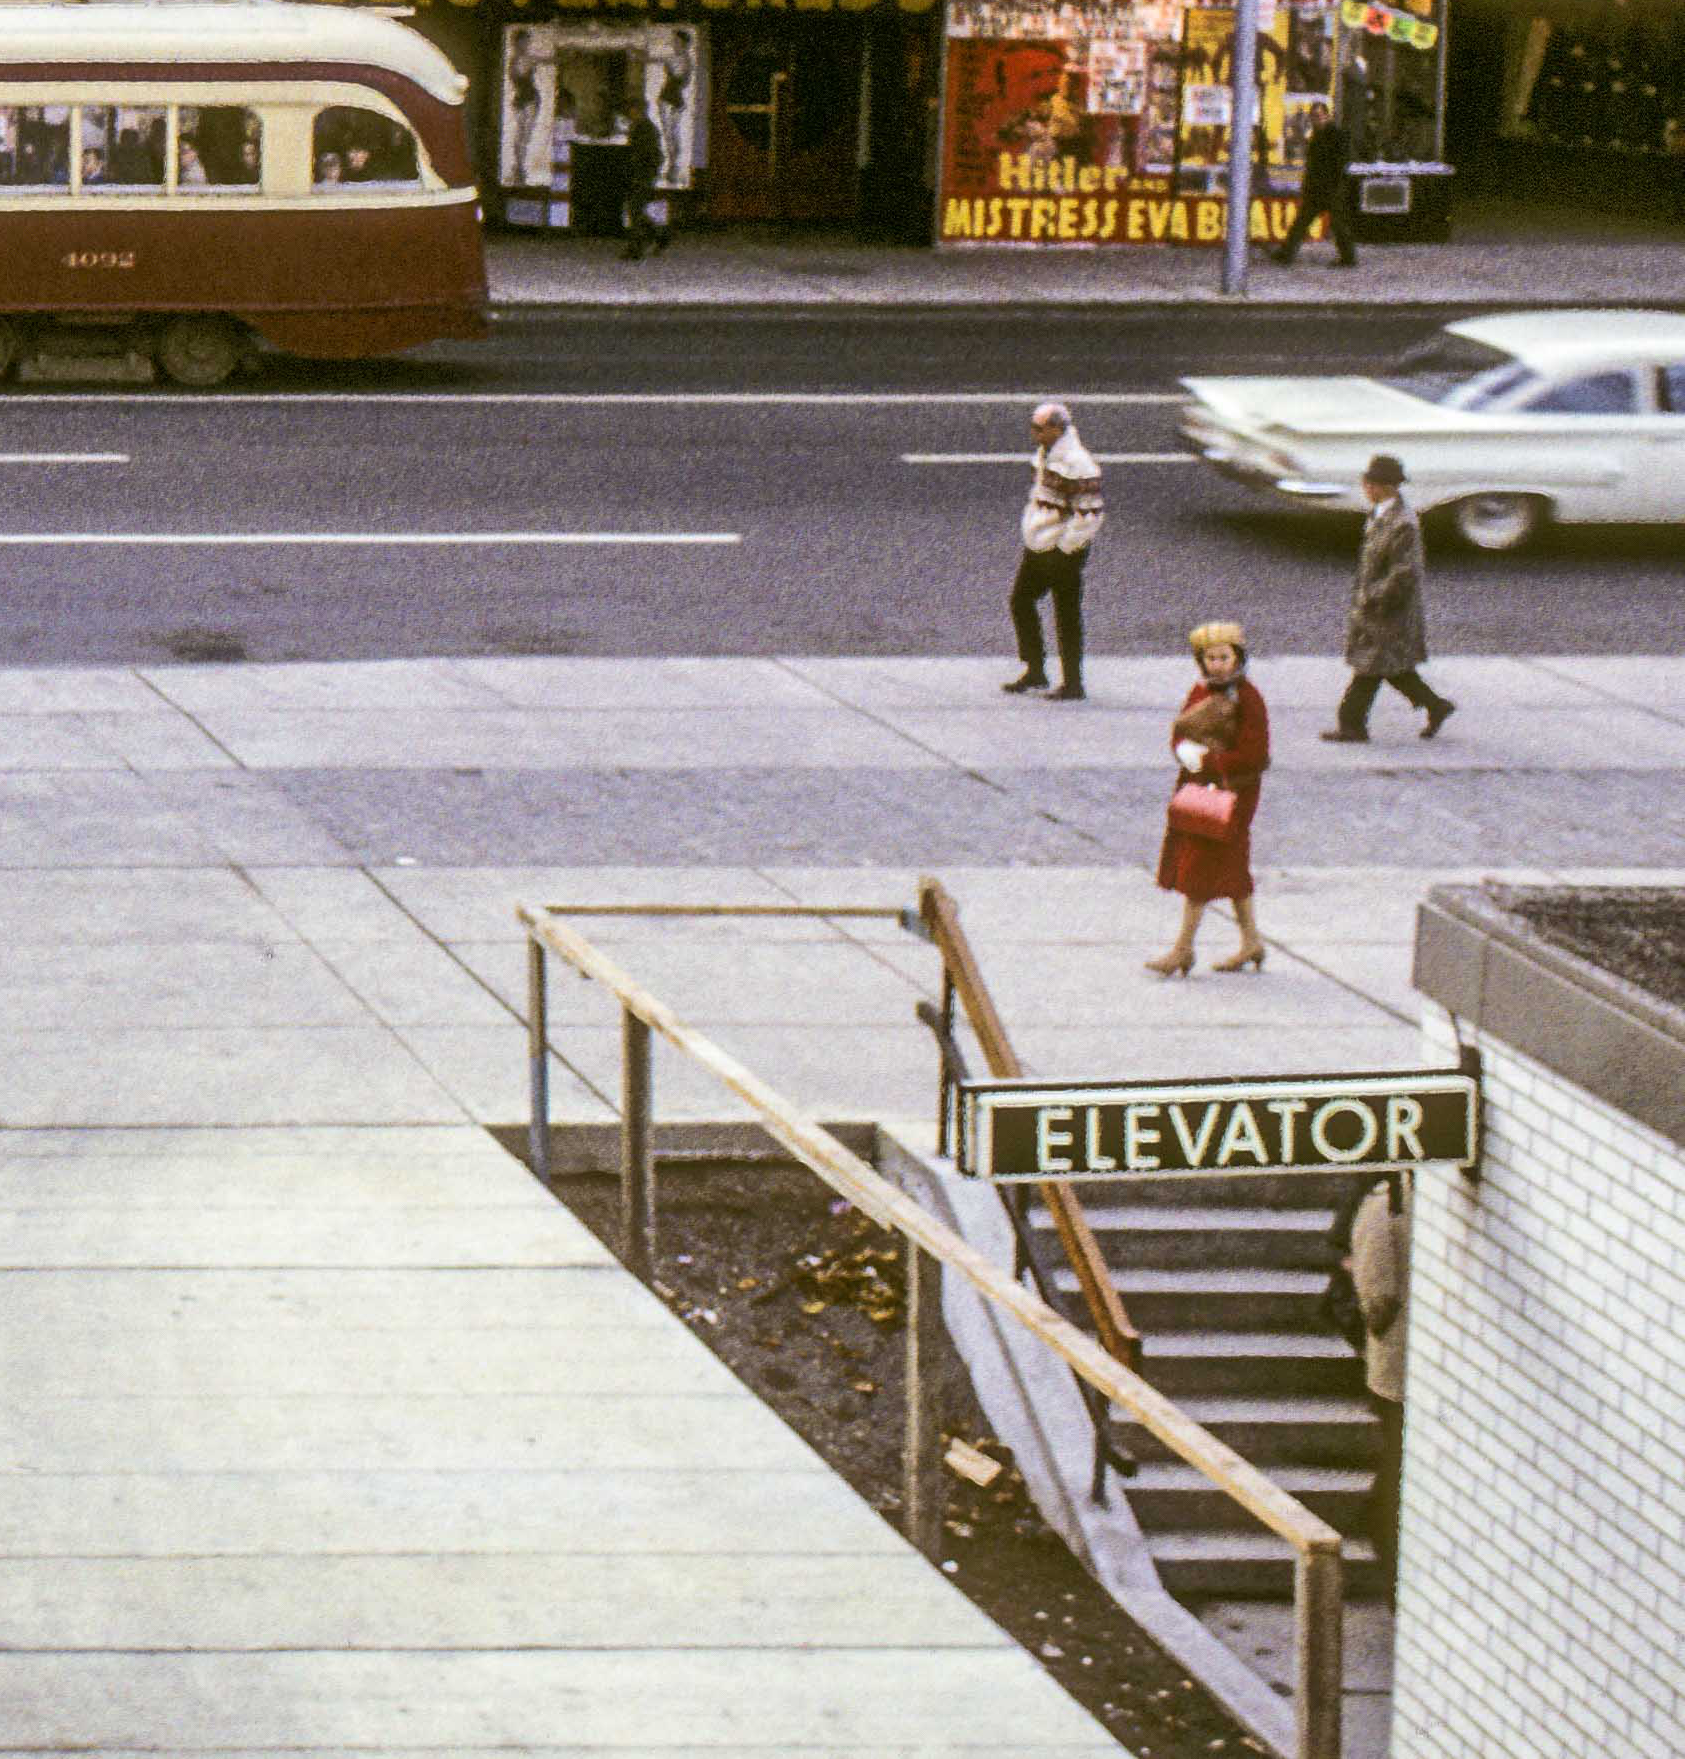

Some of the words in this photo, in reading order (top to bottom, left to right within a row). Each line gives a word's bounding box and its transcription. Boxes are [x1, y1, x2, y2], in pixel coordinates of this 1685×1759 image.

[998, 152, 1129, 192] Hitler
[943, 197, 1119, 239] MISTRESS
[1128, 198, 1190, 239] EVA
[1197, 198, 1325, 239] BAU
[61, 251, 135, 269] 4092
[1037, 1096, 1424, 1171] ELEVATOR
